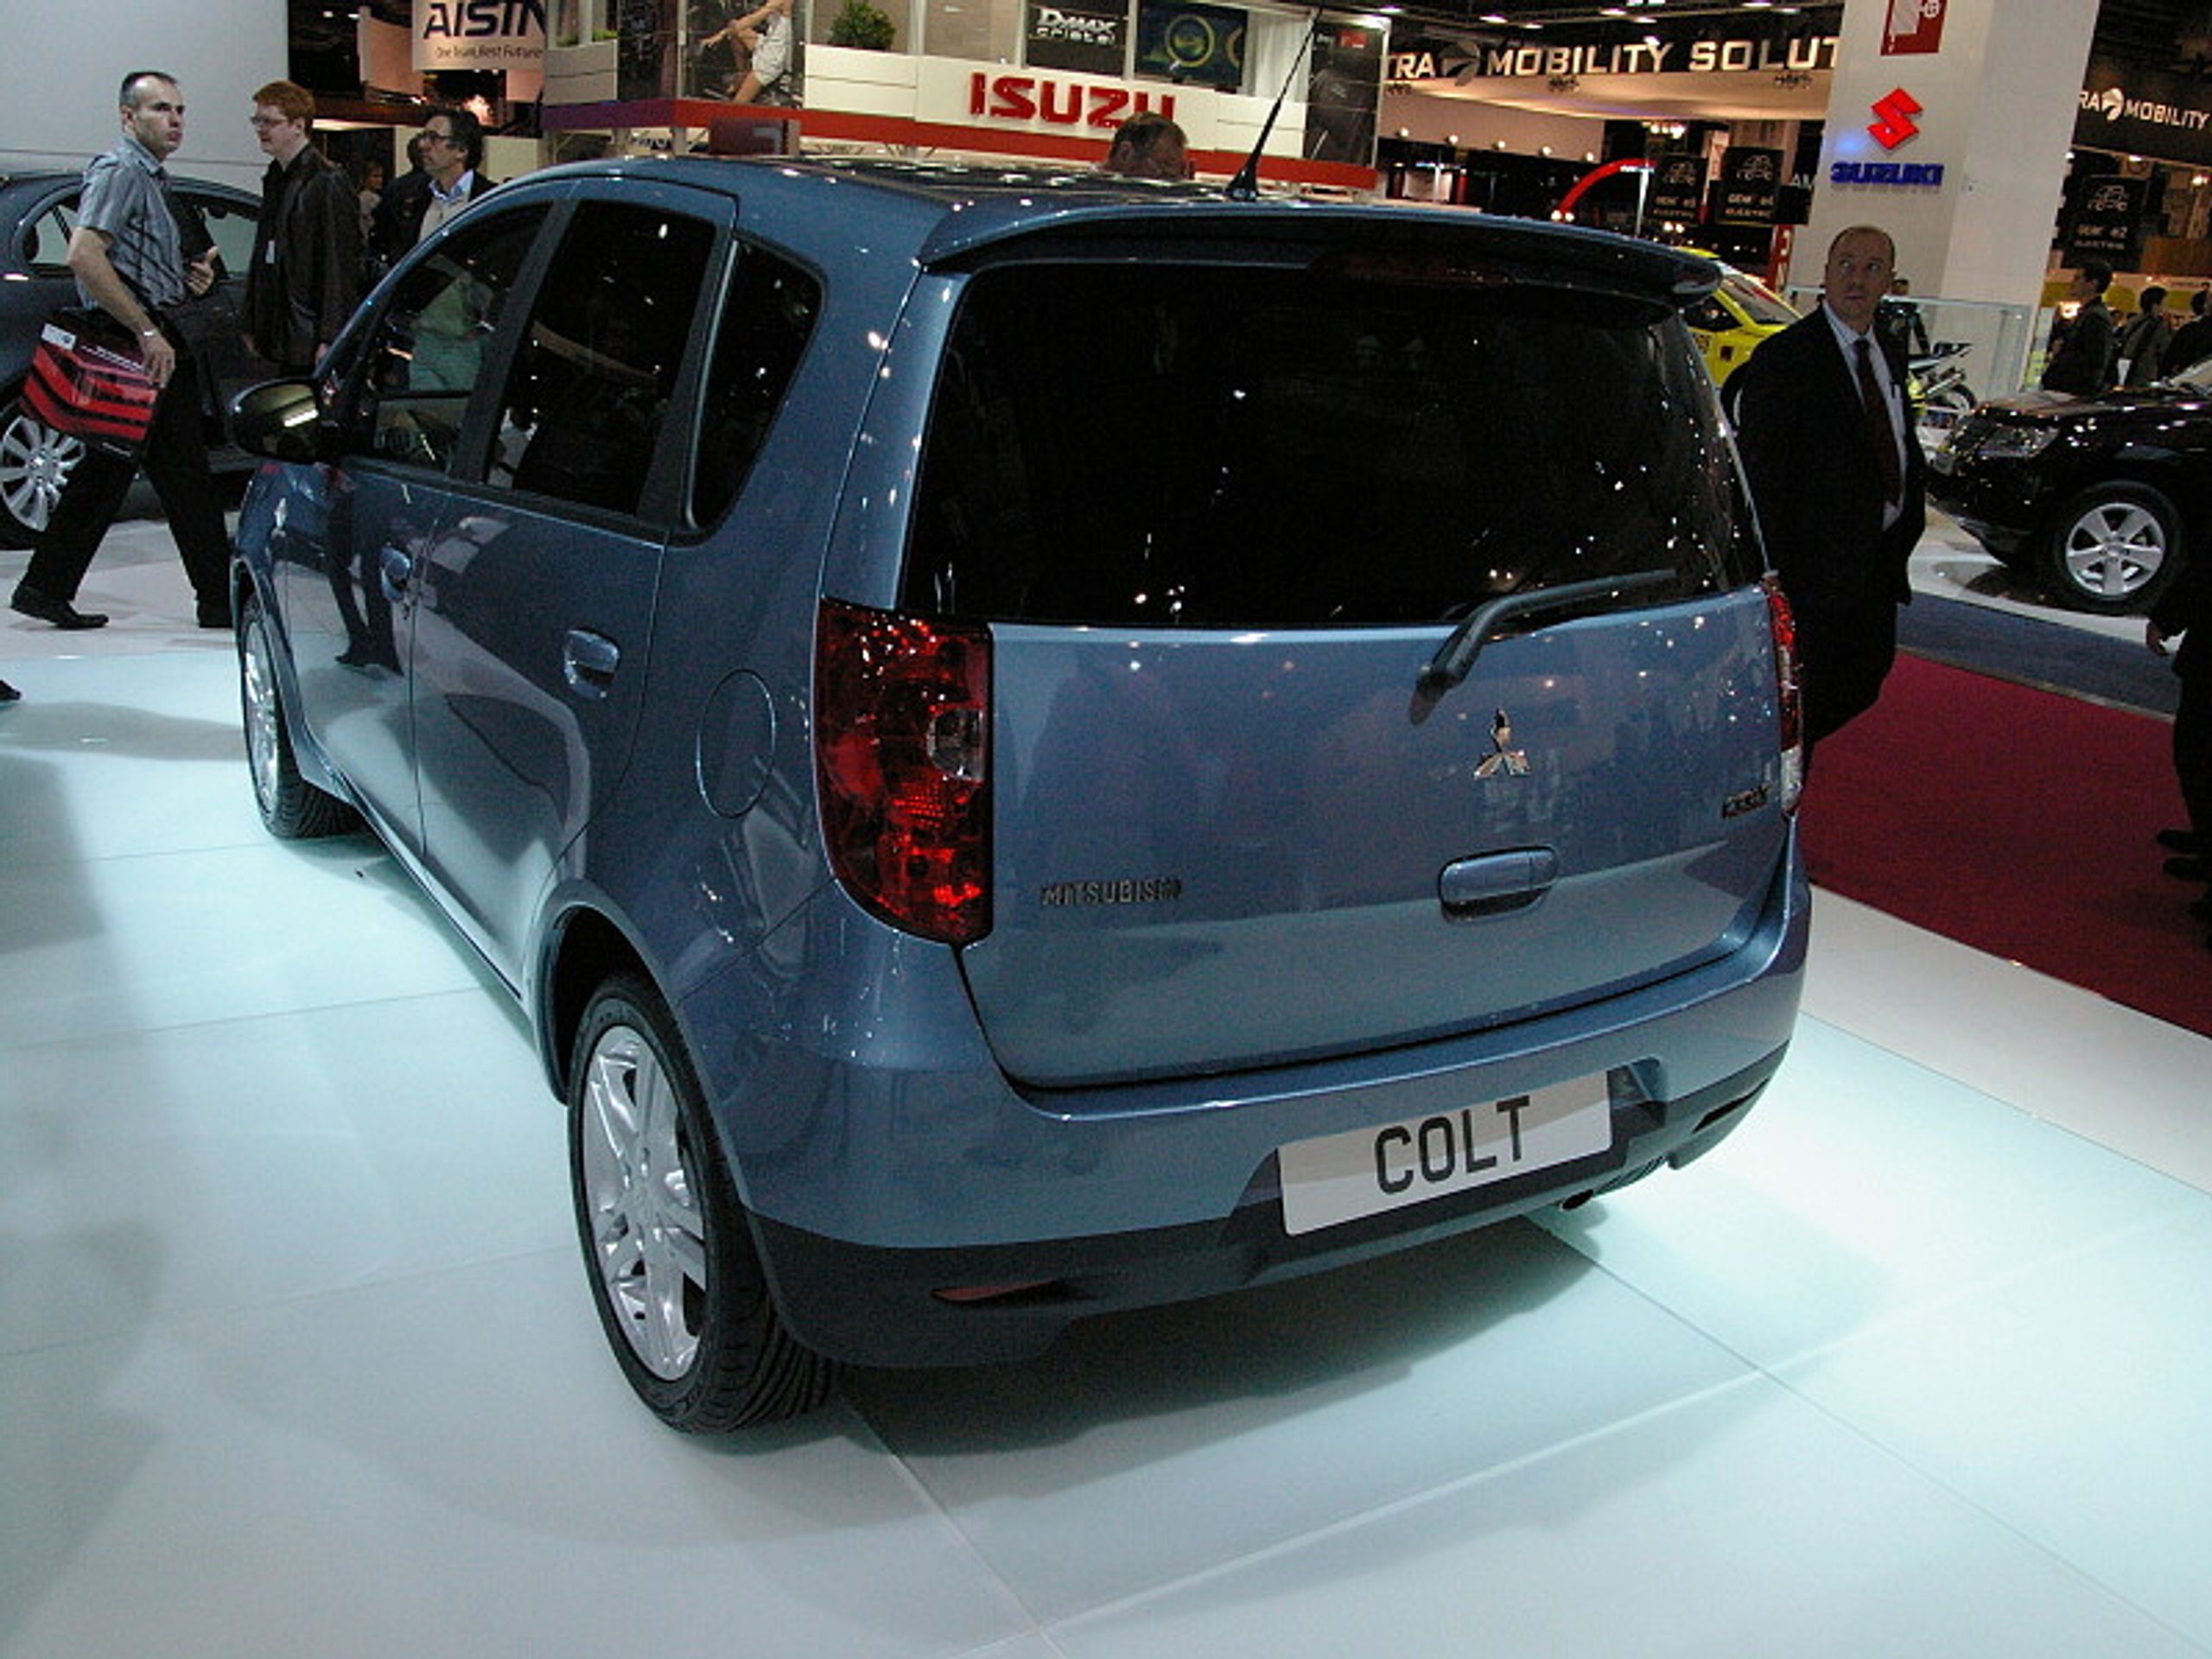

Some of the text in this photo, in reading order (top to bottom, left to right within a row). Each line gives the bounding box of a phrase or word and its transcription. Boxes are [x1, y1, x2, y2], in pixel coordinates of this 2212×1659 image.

[423, 0, 547, 40] AISIN
[1387, 53, 1436, 79] RA
[1486, 41, 1672, 76] MOBILITY
[2124, 99, 2210, 130] MOBILITY
[1830, 162, 1943, 185] SUZUKI
[1375, 1095, 1530, 1194] COLT
